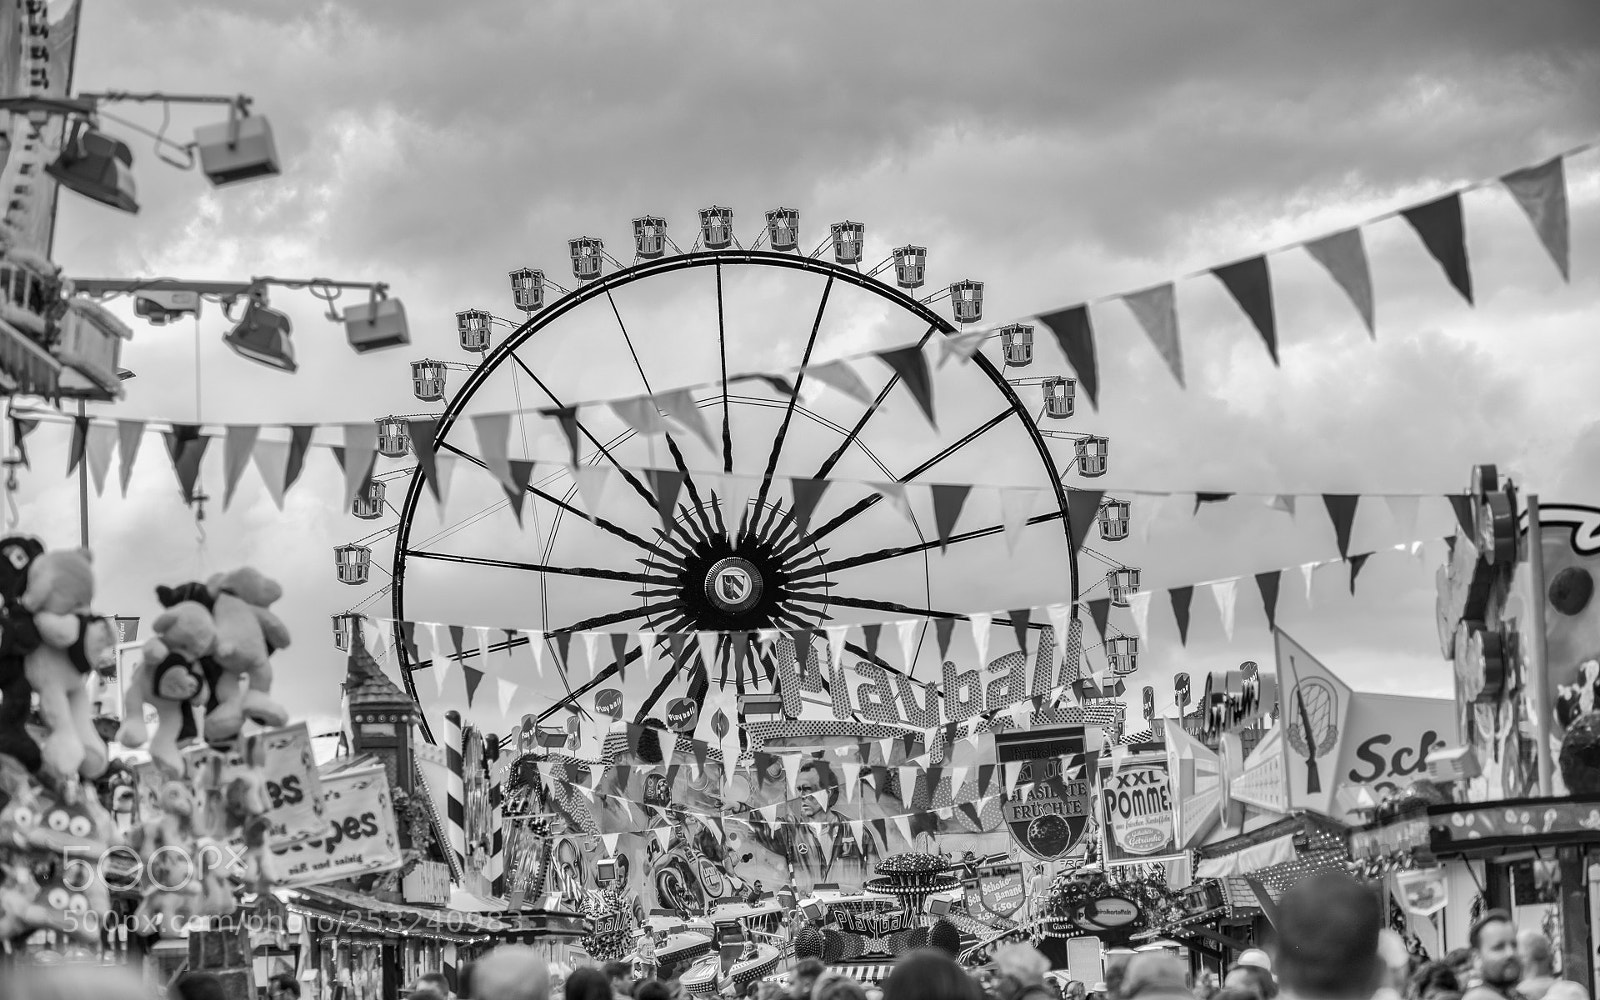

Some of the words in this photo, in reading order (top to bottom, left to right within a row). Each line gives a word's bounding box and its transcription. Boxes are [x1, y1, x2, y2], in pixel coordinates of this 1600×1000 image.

[1116, 770, 1161, 790] XXL
[982, 878, 1012, 896] Schoko-
[994, 884, 1023, 902] Banane
[834, 903, 917, 941] Playball
